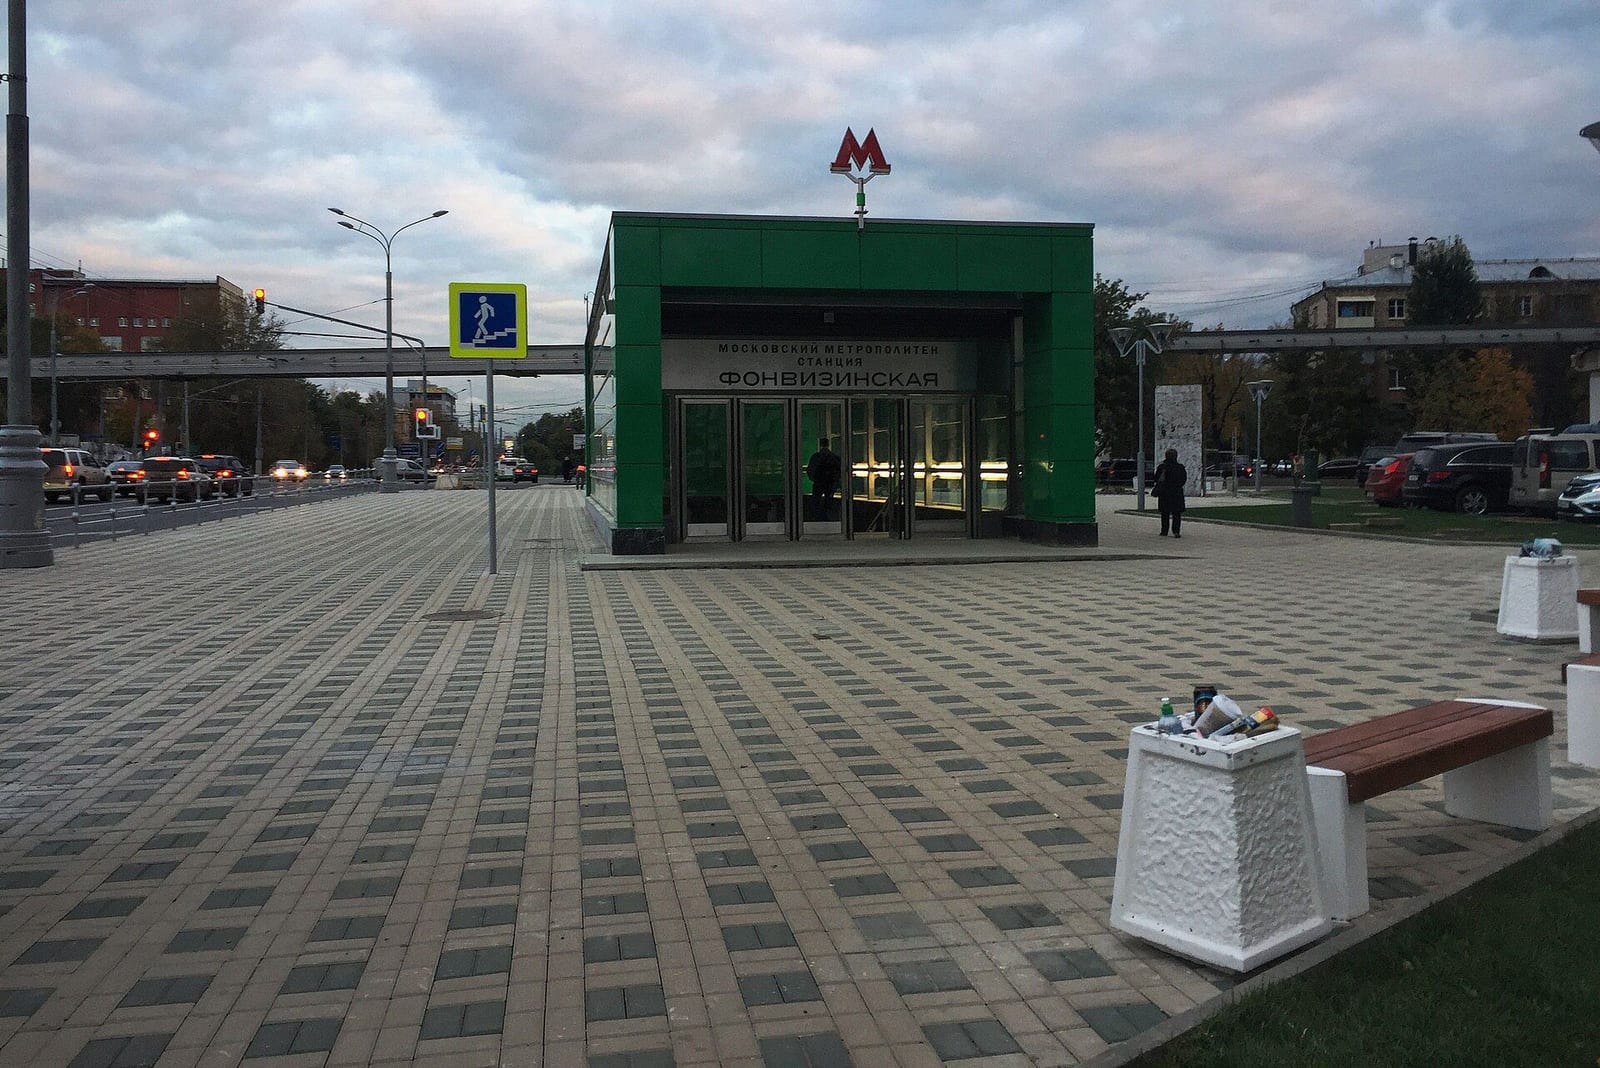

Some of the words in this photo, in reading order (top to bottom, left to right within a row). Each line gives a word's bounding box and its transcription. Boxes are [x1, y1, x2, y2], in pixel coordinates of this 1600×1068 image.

[830, 126, 891, 174] М
[718, 342, 818, 354] МОСКОВСКИЙ
[824, 344, 939, 355] МЕТРОПОЛИТЕН
[797, 357, 862, 368] СТАНЦИЯ
[719, 371, 938, 387] ФОНВИЗИНСКАЯ
